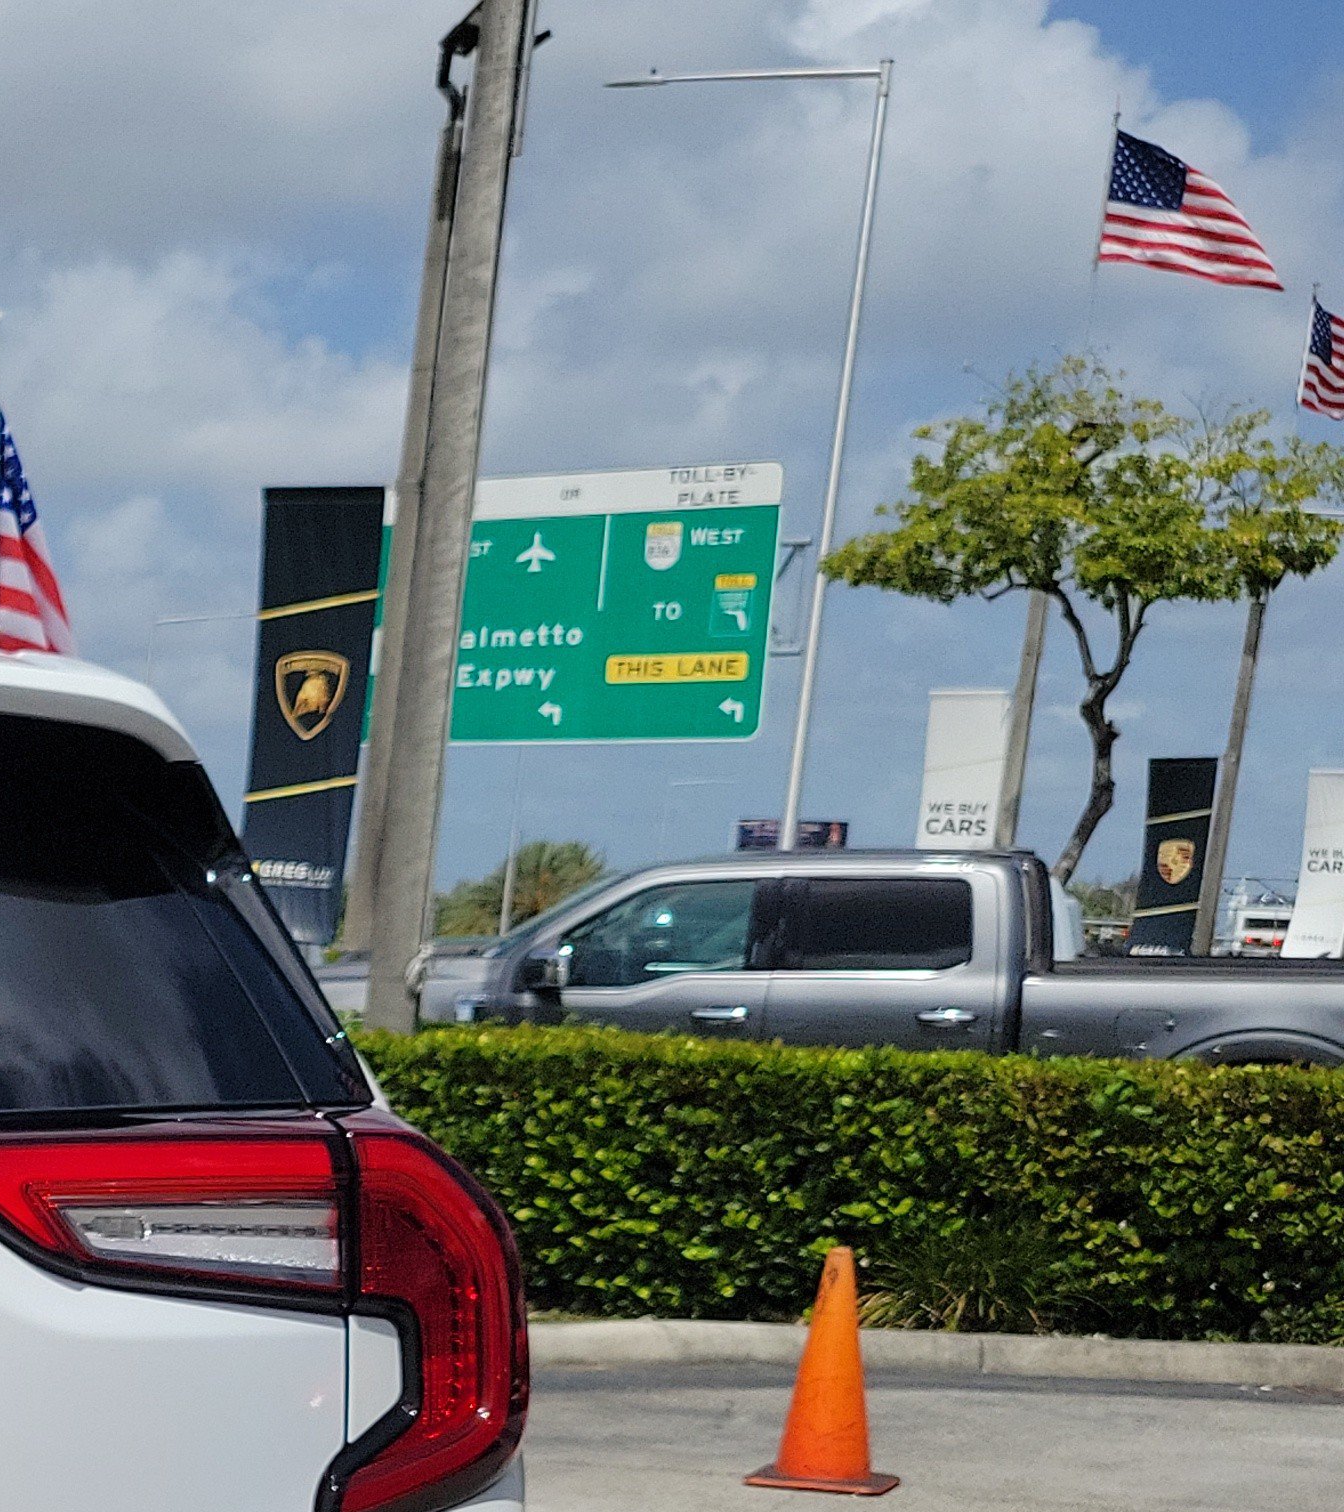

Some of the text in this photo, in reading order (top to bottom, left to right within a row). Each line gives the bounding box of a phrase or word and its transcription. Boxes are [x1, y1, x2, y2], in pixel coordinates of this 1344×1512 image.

[677, 490, 740, 506] PLATE
[690, 526, 745, 546] WEST
[652, 601, 682, 621] TO
[459, 622, 584, 650] almetto
[456, 662, 556, 692] Expwy
[615, 659, 739, 678] THIS LANE
[928, 802, 954, 816] WE
[925, 818, 987, 837] CARS
[1307, 859, 1344, 874] CAR
